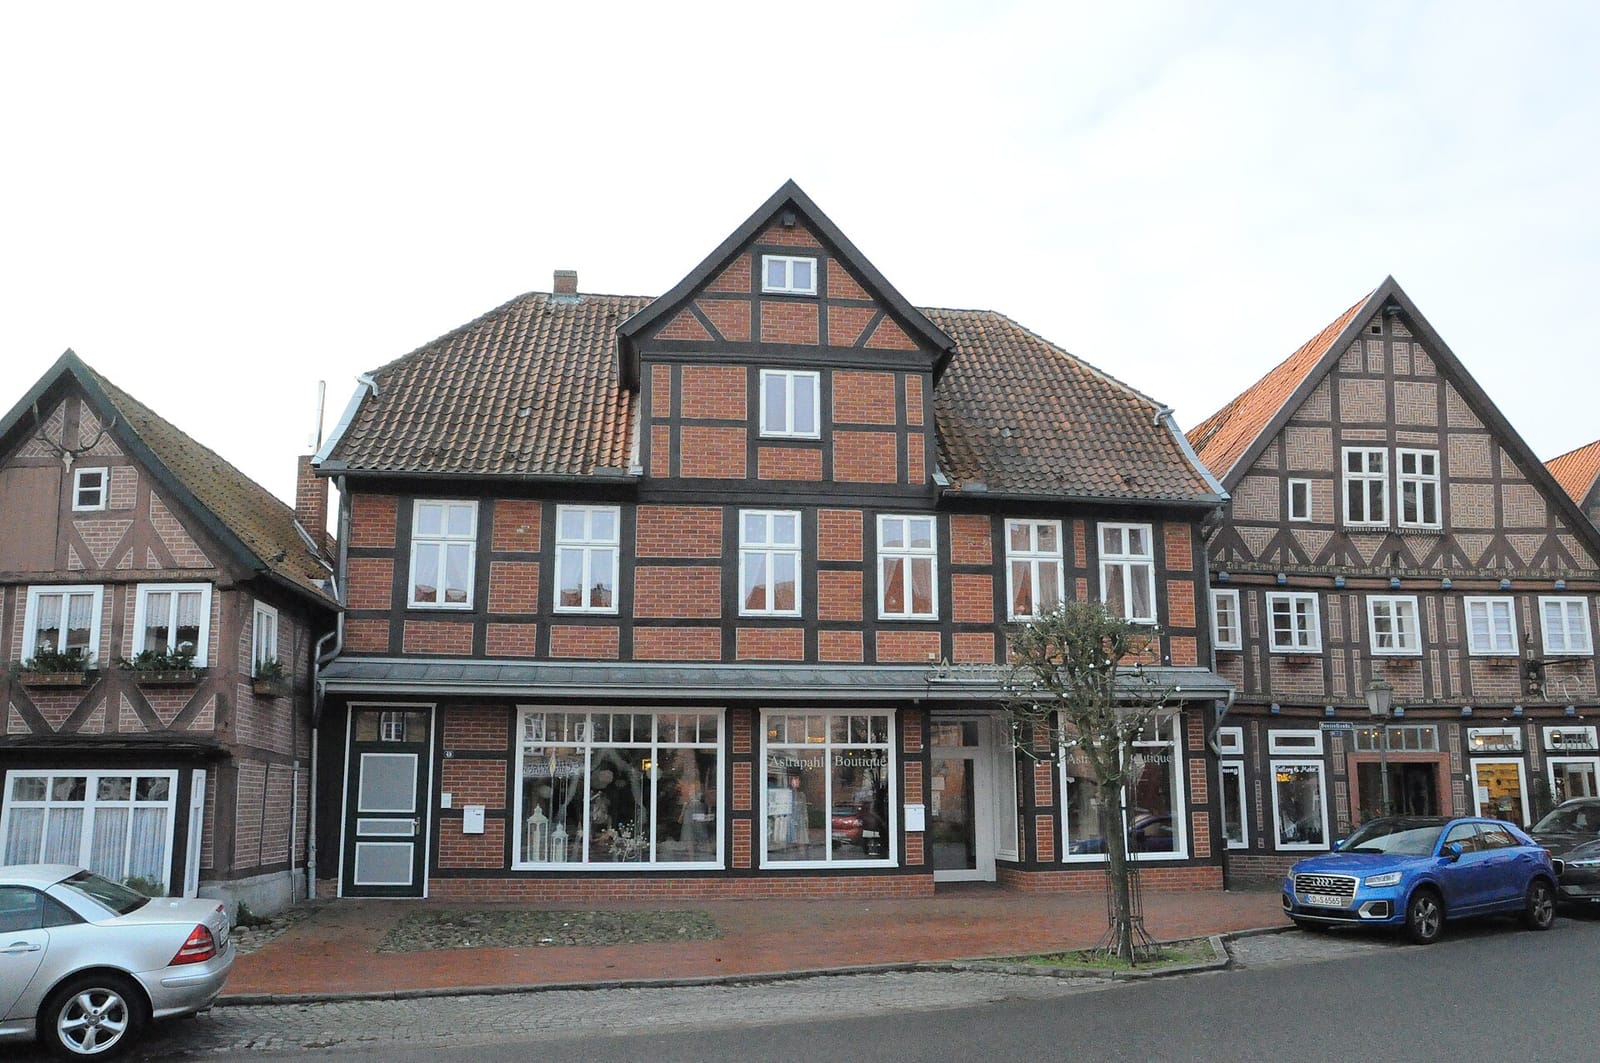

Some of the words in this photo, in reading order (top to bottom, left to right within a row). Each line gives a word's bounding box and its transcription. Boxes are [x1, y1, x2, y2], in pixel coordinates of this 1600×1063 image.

[770, 755, 825, 770] Astrapahl
[834, 755, 887, 770] Boutique
[1068, 753, 1113, 766] Astrl
[1128, 752, 1172, 766] utique
